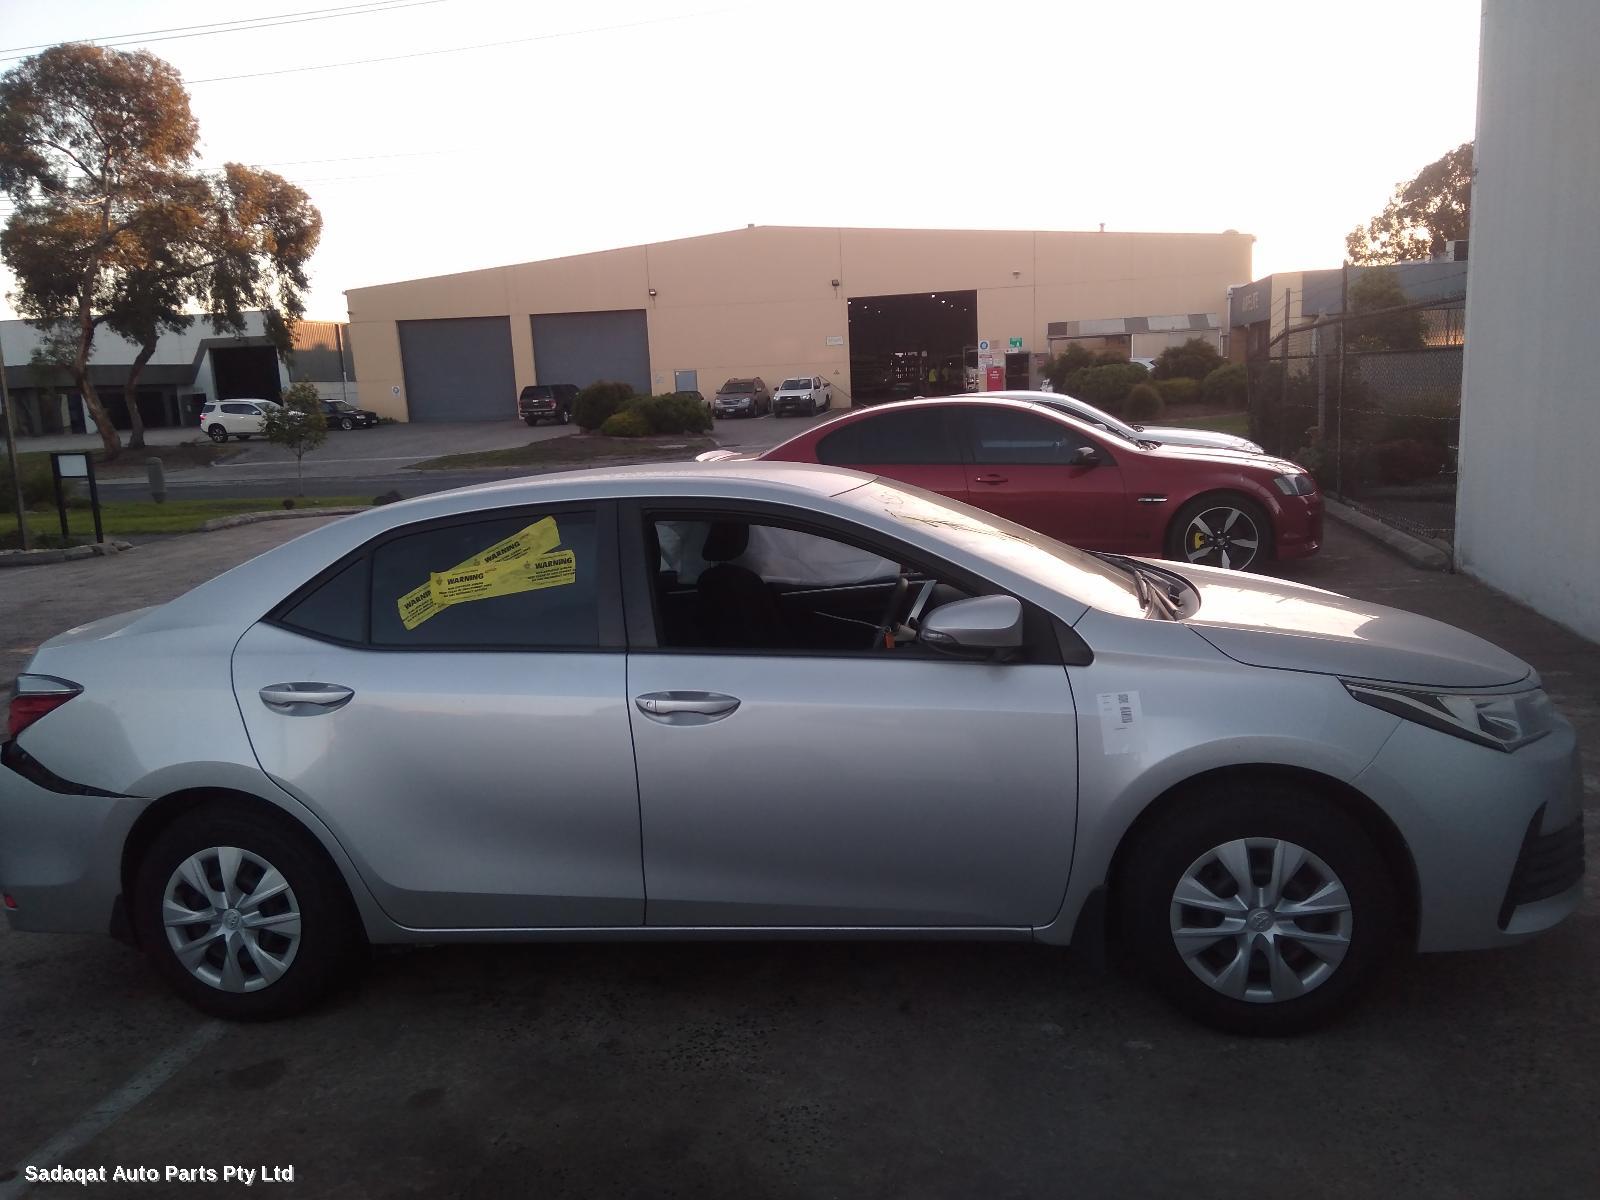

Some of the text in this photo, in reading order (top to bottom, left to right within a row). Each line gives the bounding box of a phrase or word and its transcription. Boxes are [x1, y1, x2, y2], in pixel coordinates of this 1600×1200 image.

[484, 541, 521, 563] WARNING
[535, 557, 573, 569] WARNING
[447, 572, 484, 585] WARNING
[404, 590, 432, 610] WARNI
